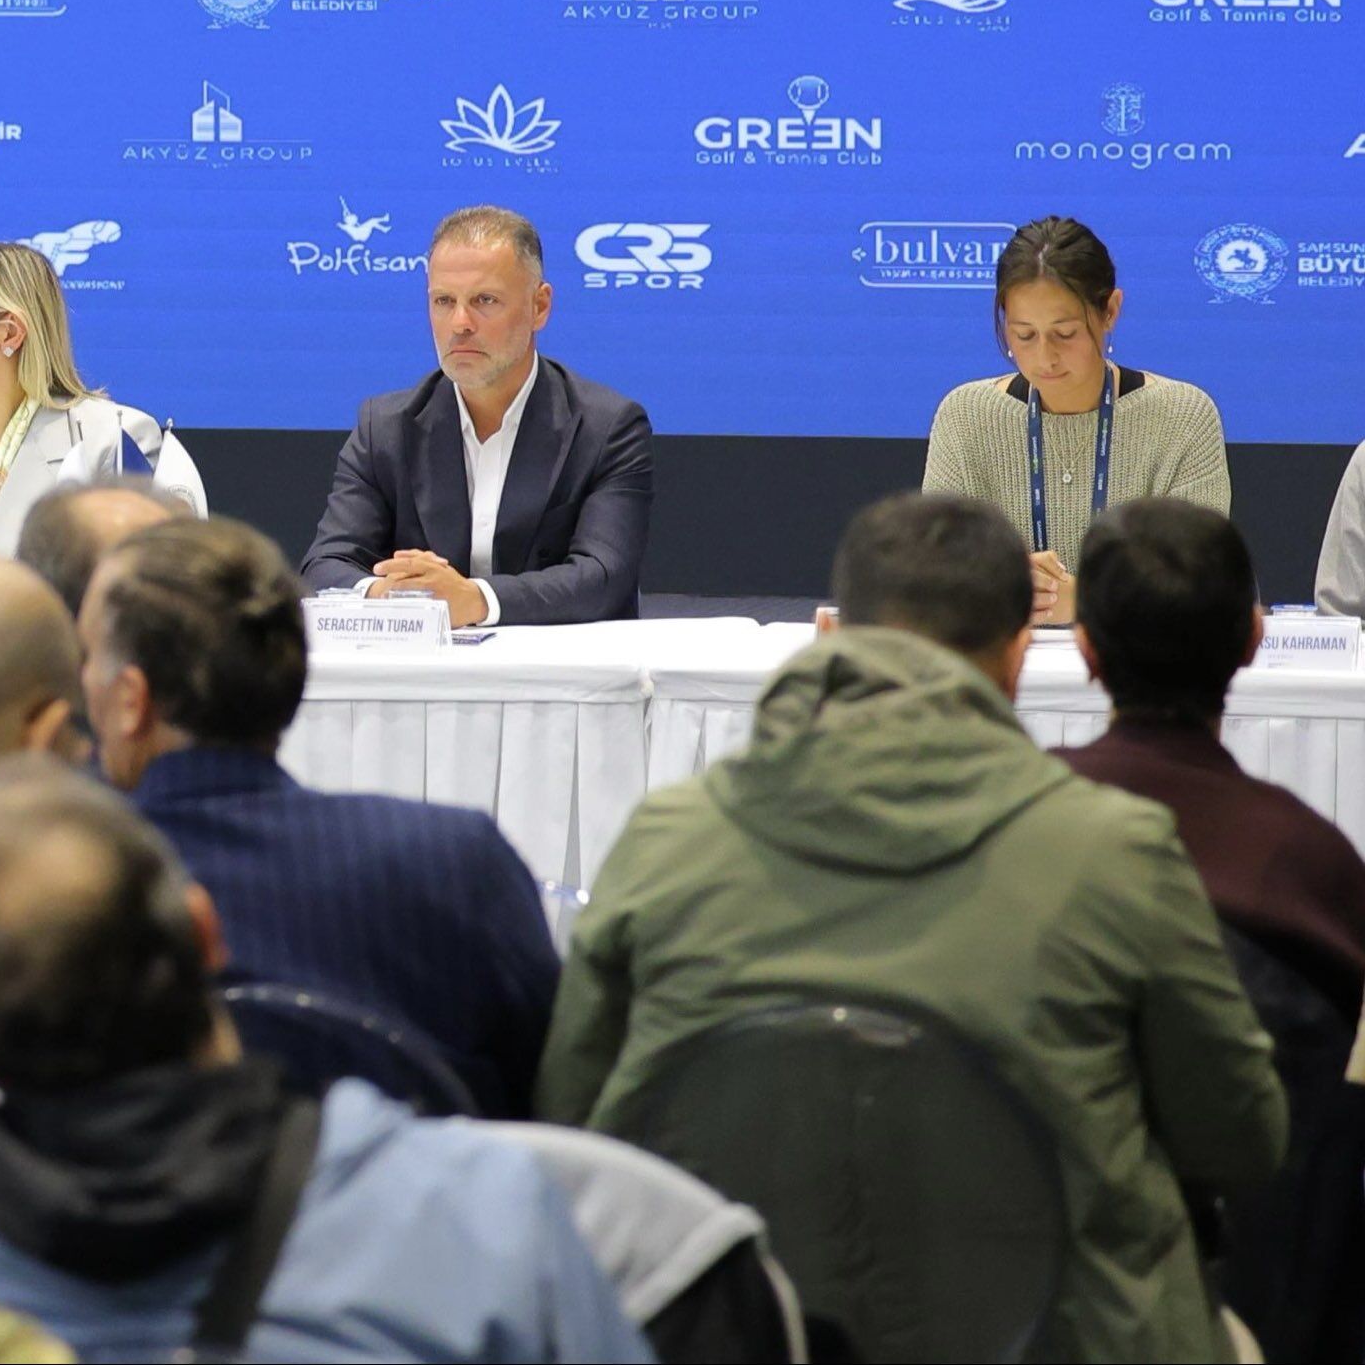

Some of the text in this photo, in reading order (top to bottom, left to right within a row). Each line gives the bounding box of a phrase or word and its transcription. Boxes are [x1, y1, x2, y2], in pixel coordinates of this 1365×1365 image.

[1150, 6, 1191, 21] Golf
[1199, 8, 1212, 21] &
[695, 115, 881, 149] GREEN
[221, 147, 312, 160] GROUP
[697, 148, 735, 163] Golf
[744, 150, 755, 164] &
[1016, 142, 1230, 169] monogram
[876, 230, 1007, 264] bulvar
[287, 239, 429, 275] Polfisan
[584, 273, 704, 288] SPOR
[317, 617, 424, 633] SERACETTİN TURAN
[1282, 636, 1347, 651] KAHRAMAN
